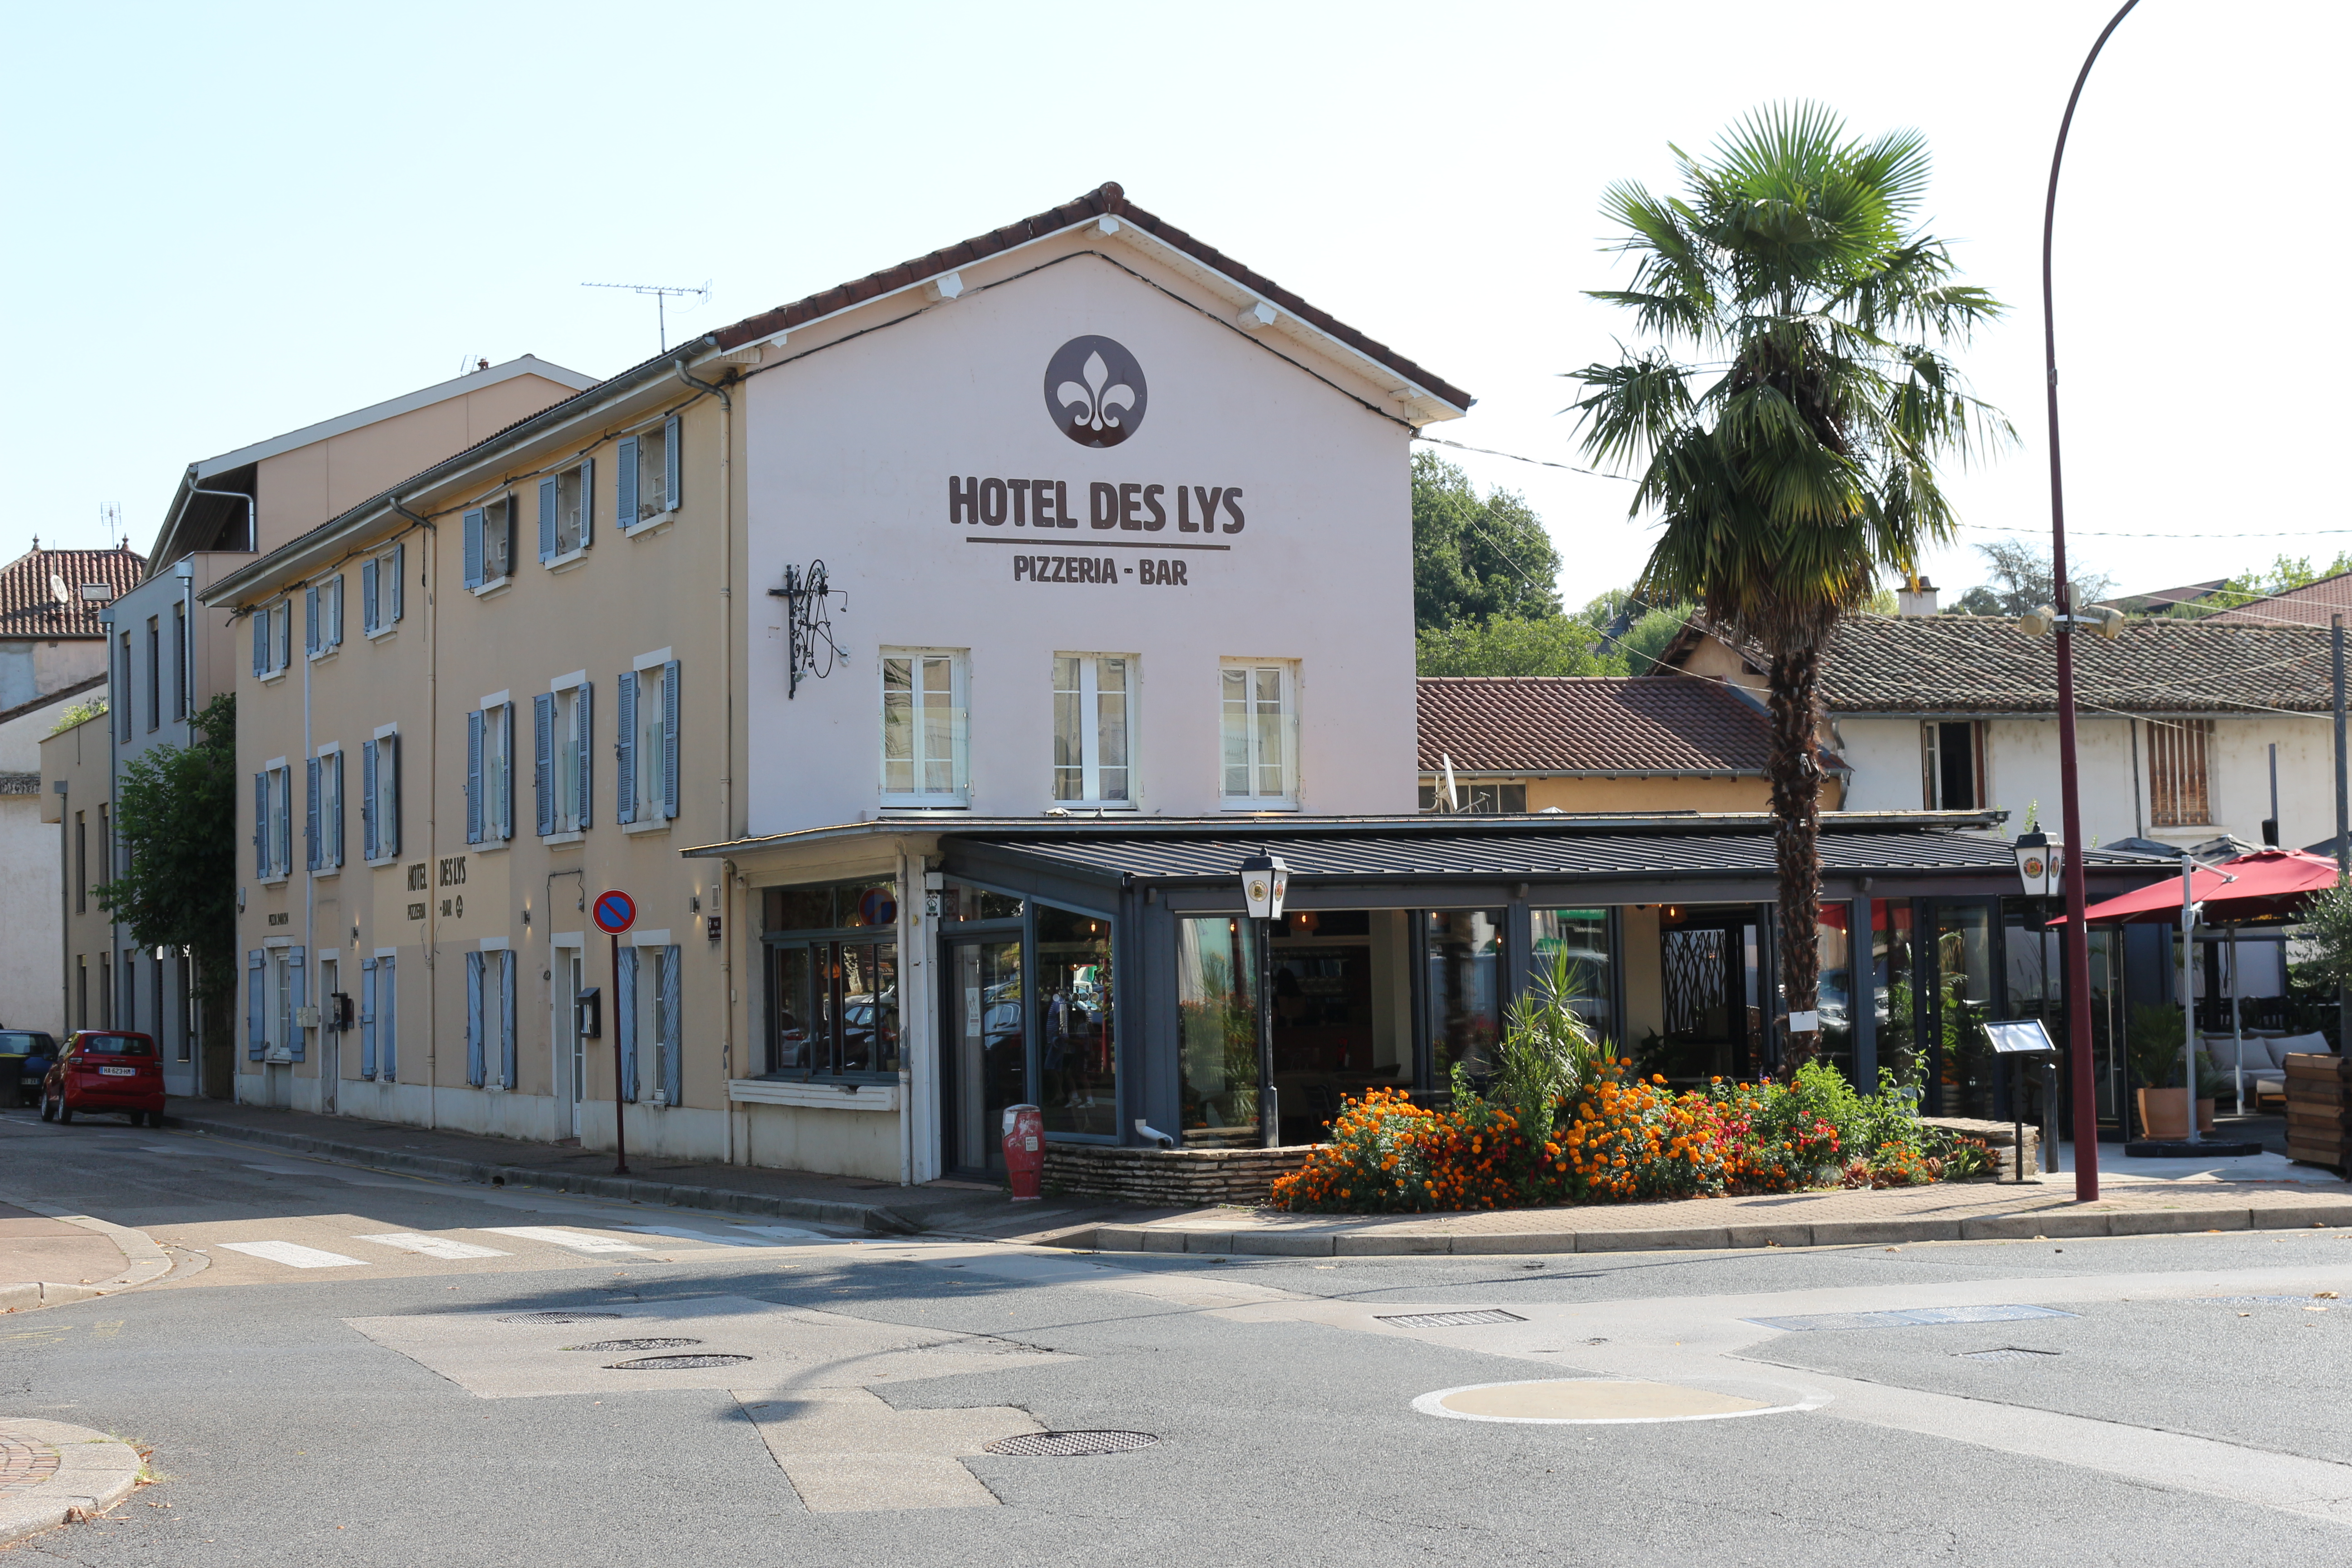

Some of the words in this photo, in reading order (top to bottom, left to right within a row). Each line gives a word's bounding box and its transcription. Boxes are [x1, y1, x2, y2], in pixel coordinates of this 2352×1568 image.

[949, 475, 1078, 529] HOTEL
[1090, 482, 1166, 532] DES
[1177, 485, 1245, 534] LYS
[1014, 555, 1118, 584] PIZZERIA
[1139, 559, 1188, 586] BAR
[408, 863, 427, 892] HOTEL
[440, 858, 453, 887] DES
[453, 856, 466, 885] LYS
[407, 902, 426, 921] PIZZERIA
[442, 899, 452, 916] BAR
